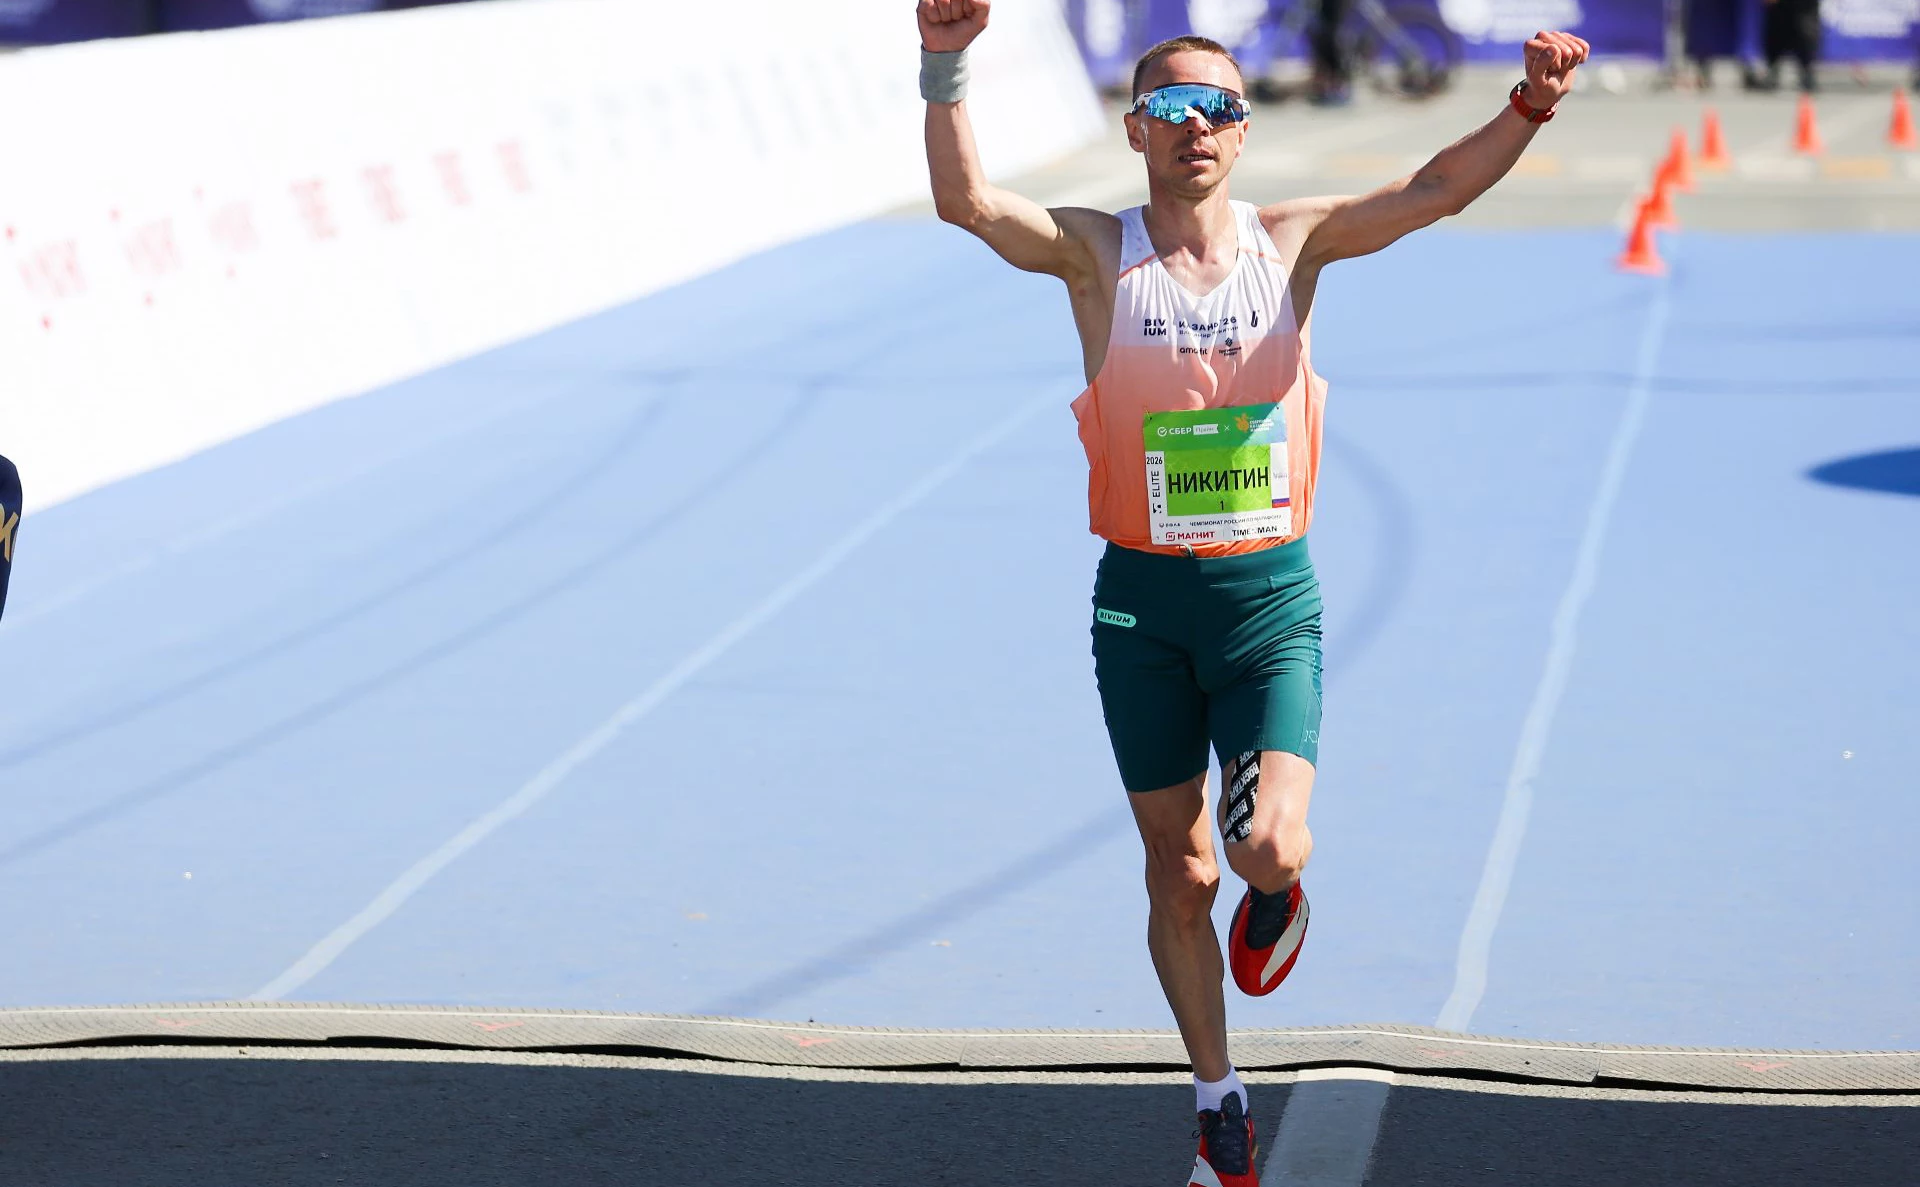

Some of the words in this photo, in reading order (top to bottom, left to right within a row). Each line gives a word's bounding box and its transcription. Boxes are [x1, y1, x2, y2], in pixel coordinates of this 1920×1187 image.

[1144, 318, 1166, 327] BIV
[1143, 327, 1167, 336] IUM
[1179, 347, 1208, 355] amafit
[1169, 427, 1192, 435] СБЕР
[1146, 456, 1163, 465] 2026
[1151, 470, 1161, 498] ELITE
[1168, 466, 1269, 494] НИКИТИН
[1219, 500, 1225, 511] 1
[1177, 531, 1215, 540] МАГНИТ
[1100, 611, 1131, 624] BIVIUM
